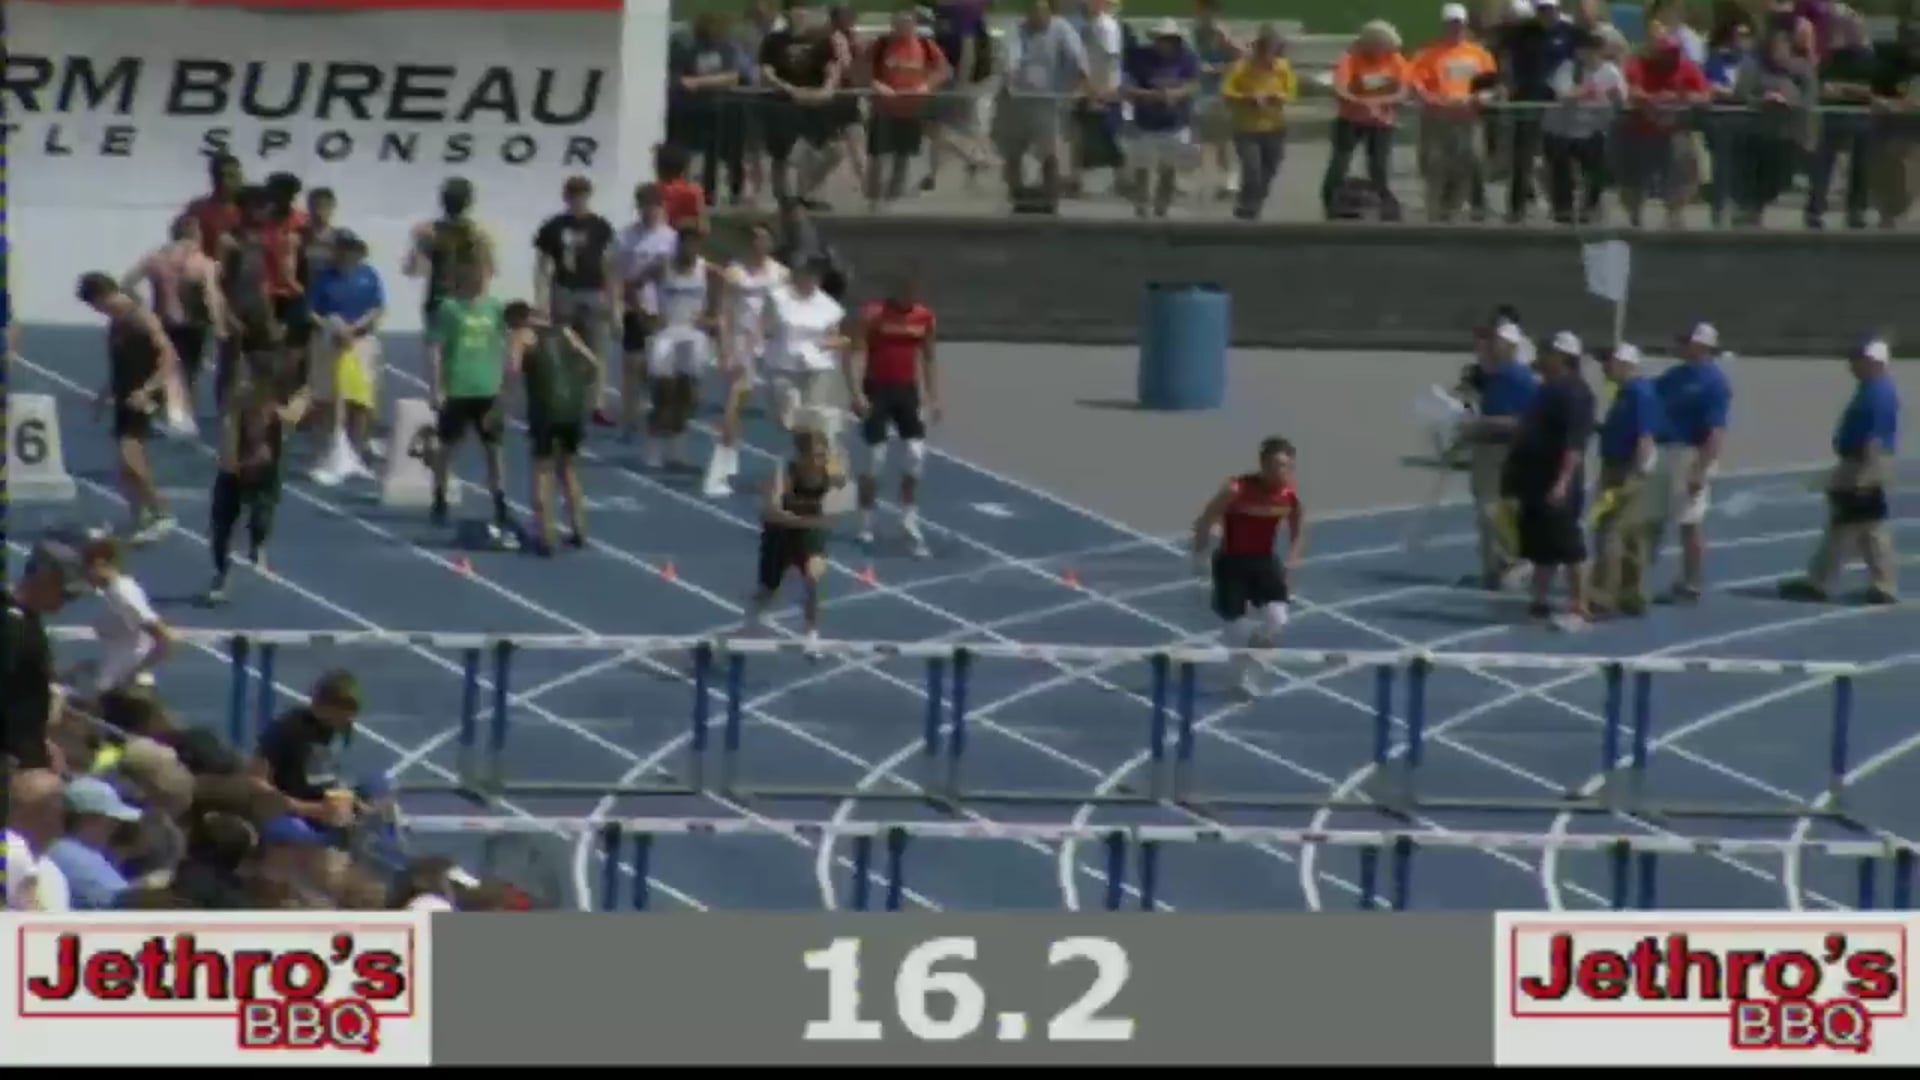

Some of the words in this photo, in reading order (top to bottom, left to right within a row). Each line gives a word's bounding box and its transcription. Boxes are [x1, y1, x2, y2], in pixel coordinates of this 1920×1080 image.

[167, 60, 603, 124] BUREAU
[200, 127, 599, 166] SPONSOR
[15, 419, 48, 464] 6
